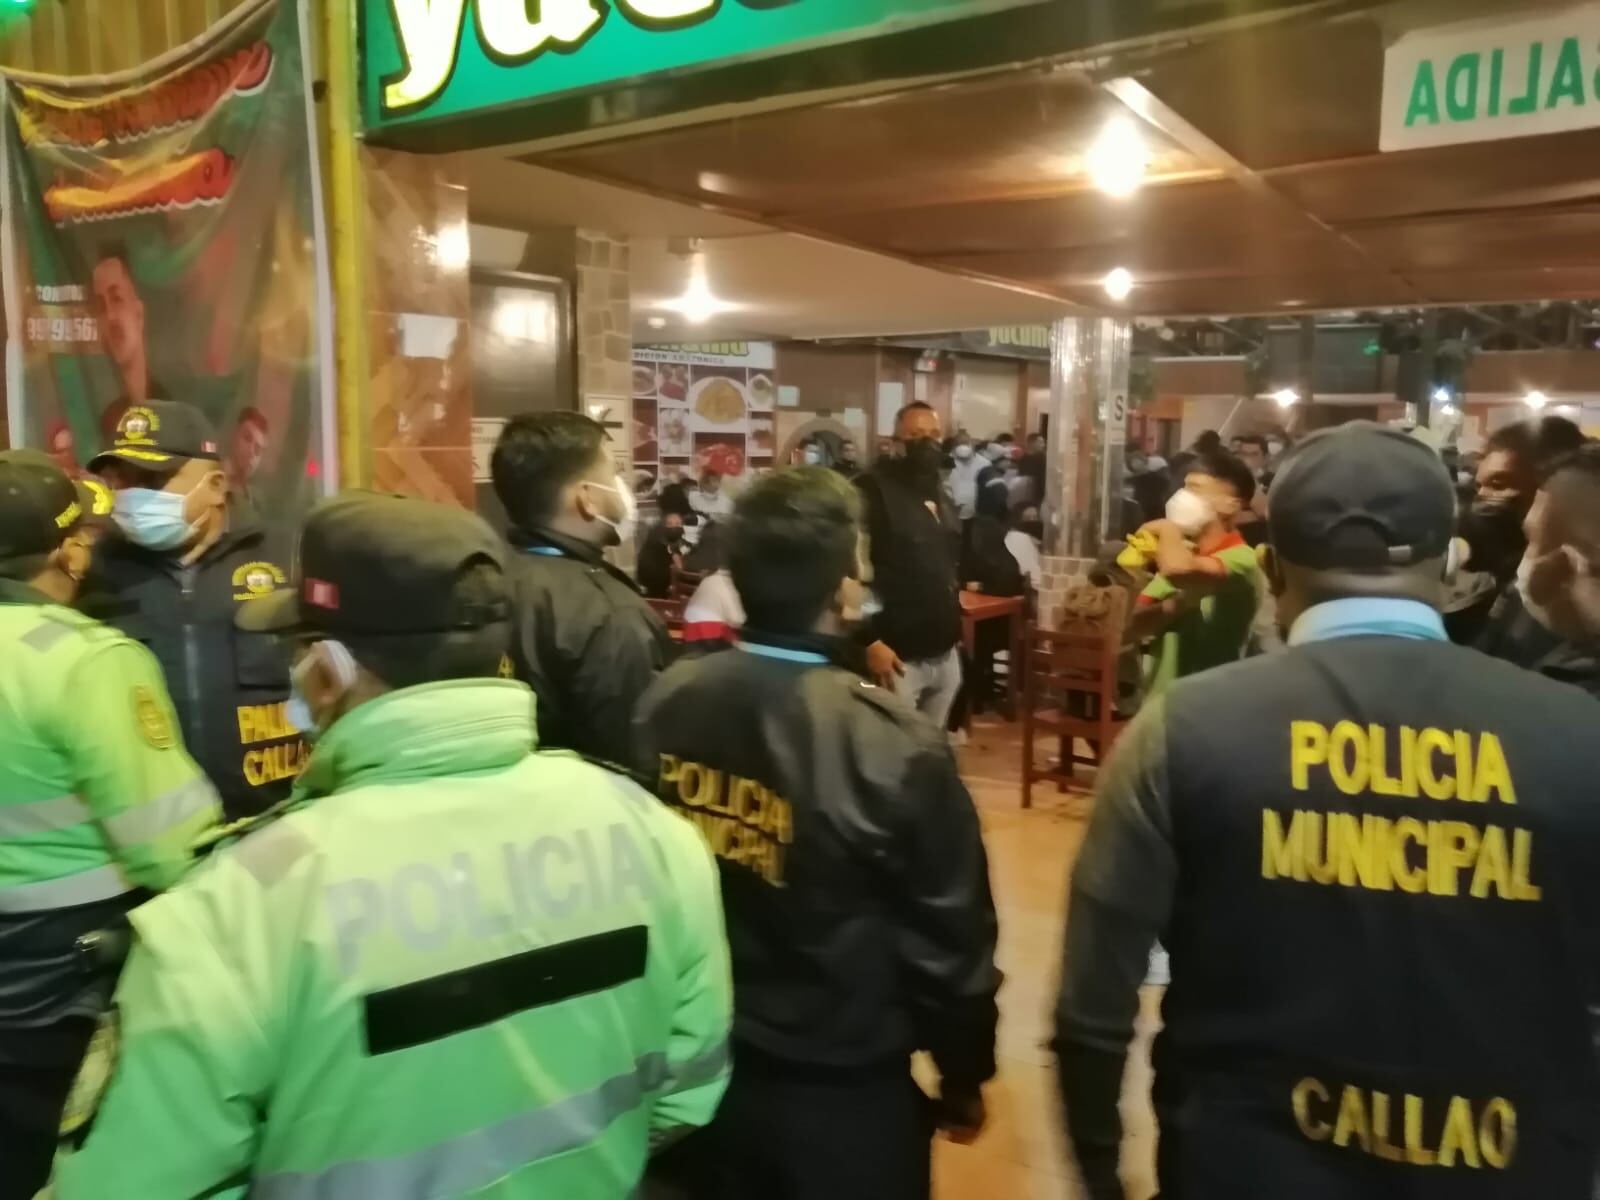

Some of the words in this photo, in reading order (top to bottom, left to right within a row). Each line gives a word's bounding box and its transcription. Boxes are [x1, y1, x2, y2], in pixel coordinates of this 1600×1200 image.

[385, 0, 717, 108] yu
[1291, 720, 1517, 804] POLICIA
[324, 822, 655, 976] POLICIA
[1262, 808, 1543, 901] MUNICIPAL
[1291, 1076, 1517, 1169] CALLAO
